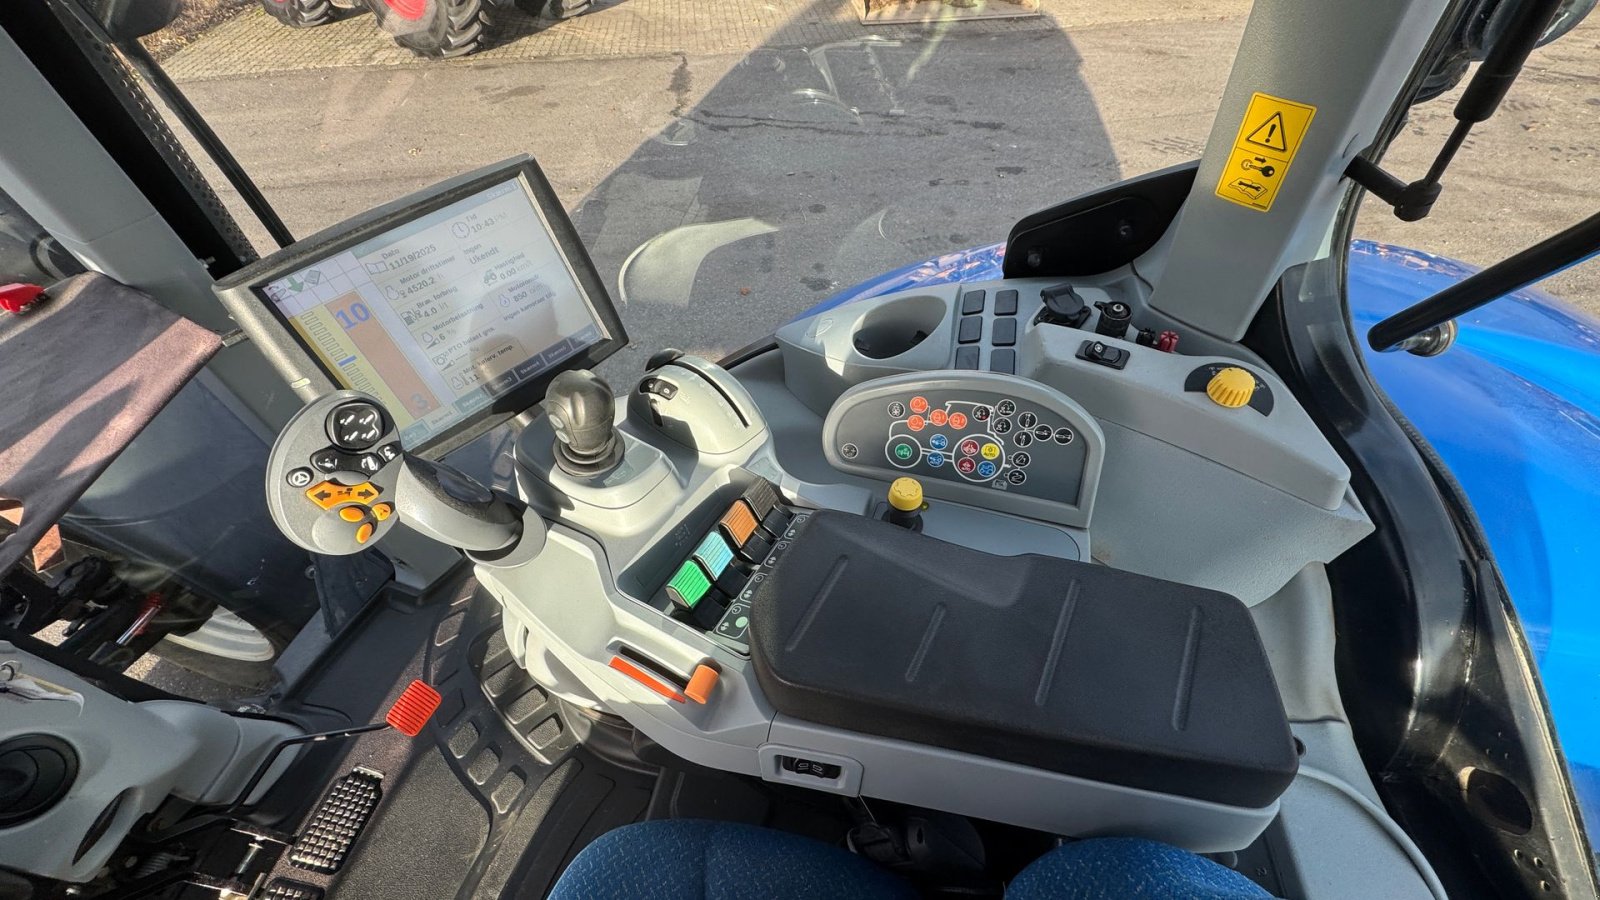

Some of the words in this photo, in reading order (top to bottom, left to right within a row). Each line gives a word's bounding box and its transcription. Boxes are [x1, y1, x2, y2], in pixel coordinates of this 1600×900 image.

[471, 218, 495, 233] 10:43
[382, 249, 400, 260] Dato
[389, 244, 437, 270] 11/19/2025
[469, 246, 500, 265] Ukendt
[400, 272, 420, 284] Motor
[407, 276, 435, 295] 4520.2
[513, 291, 528, 302] 850
[335, 302, 371, 330] 10
[424, 306, 438, 318] 4.0
[469, 373, 480, 383] 11
[410, 392, 428, 410] 3
